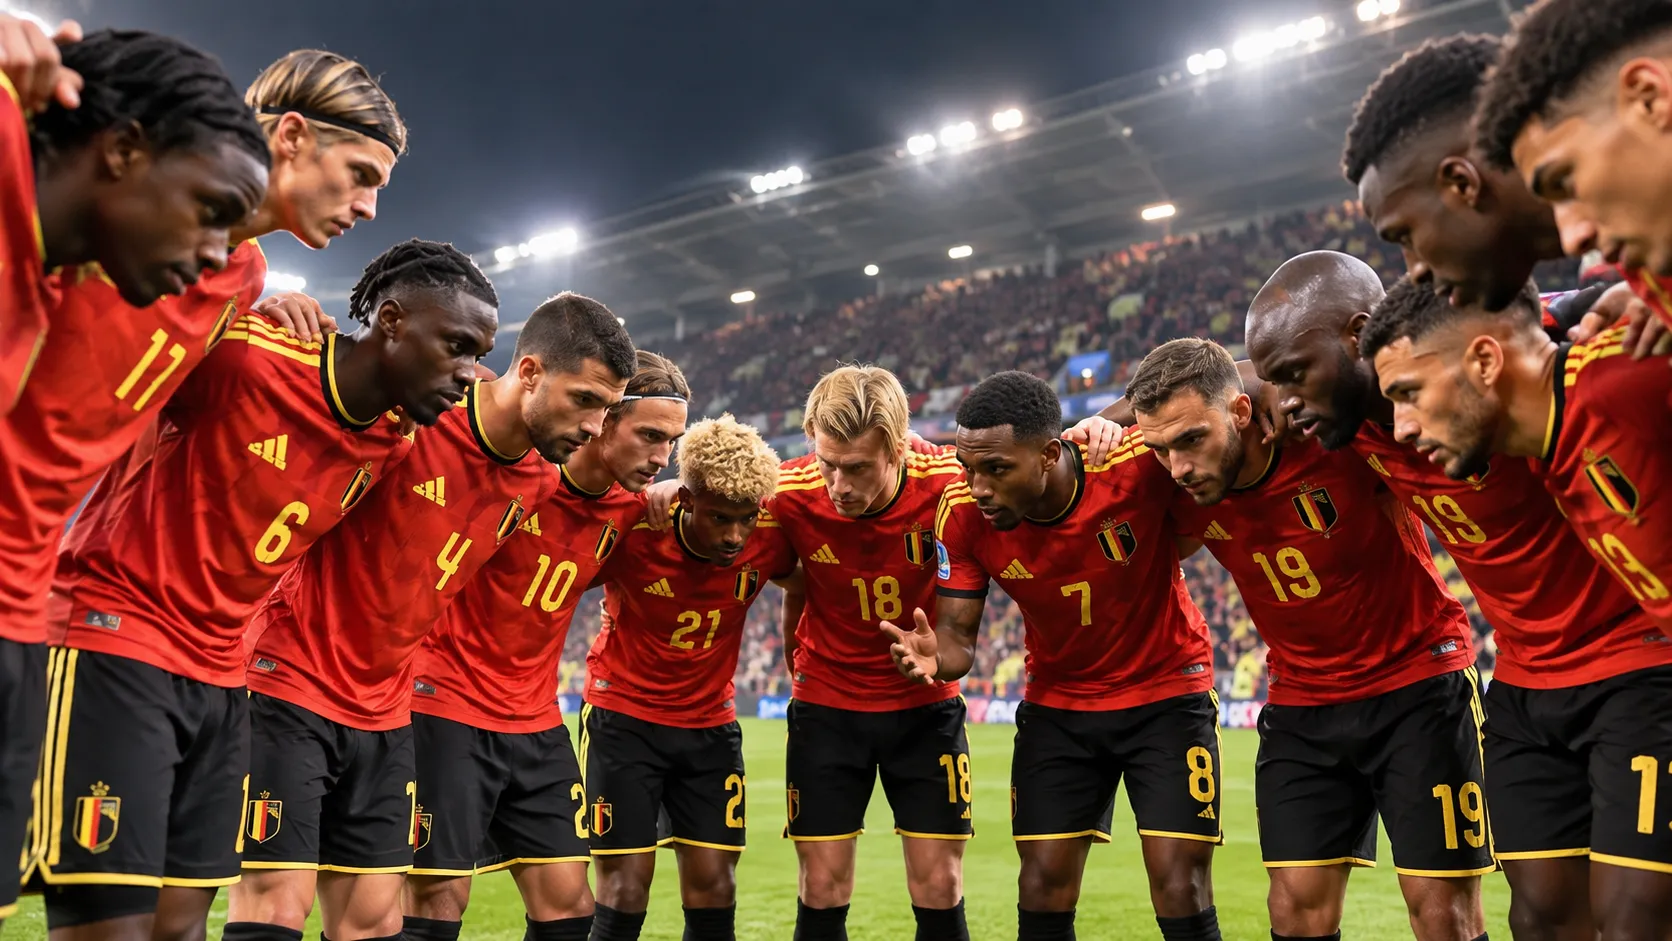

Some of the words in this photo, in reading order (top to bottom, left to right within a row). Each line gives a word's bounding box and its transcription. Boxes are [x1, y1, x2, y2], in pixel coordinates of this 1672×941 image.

[255, 501, 310, 564] 6
[1413, 495, 1487, 544] 19
[435, 531, 473, 590] 4
[521, 554, 578, 612] 10
[1252, 547, 1321, 602] 19
[1588, 533, 1669, 600] 13
[852, 575, 902, 621] 18
[1061, 581, 1092, 626] 7
[670, 609, 721, 649] 21
[725, 774, 746, 828] 2
[939, 753, 972, 804] 18
[1186, 746, 1215, 803] 8
[1631, 755, 1672, 834] 1
[1432, 782, 1486, 849] 19
